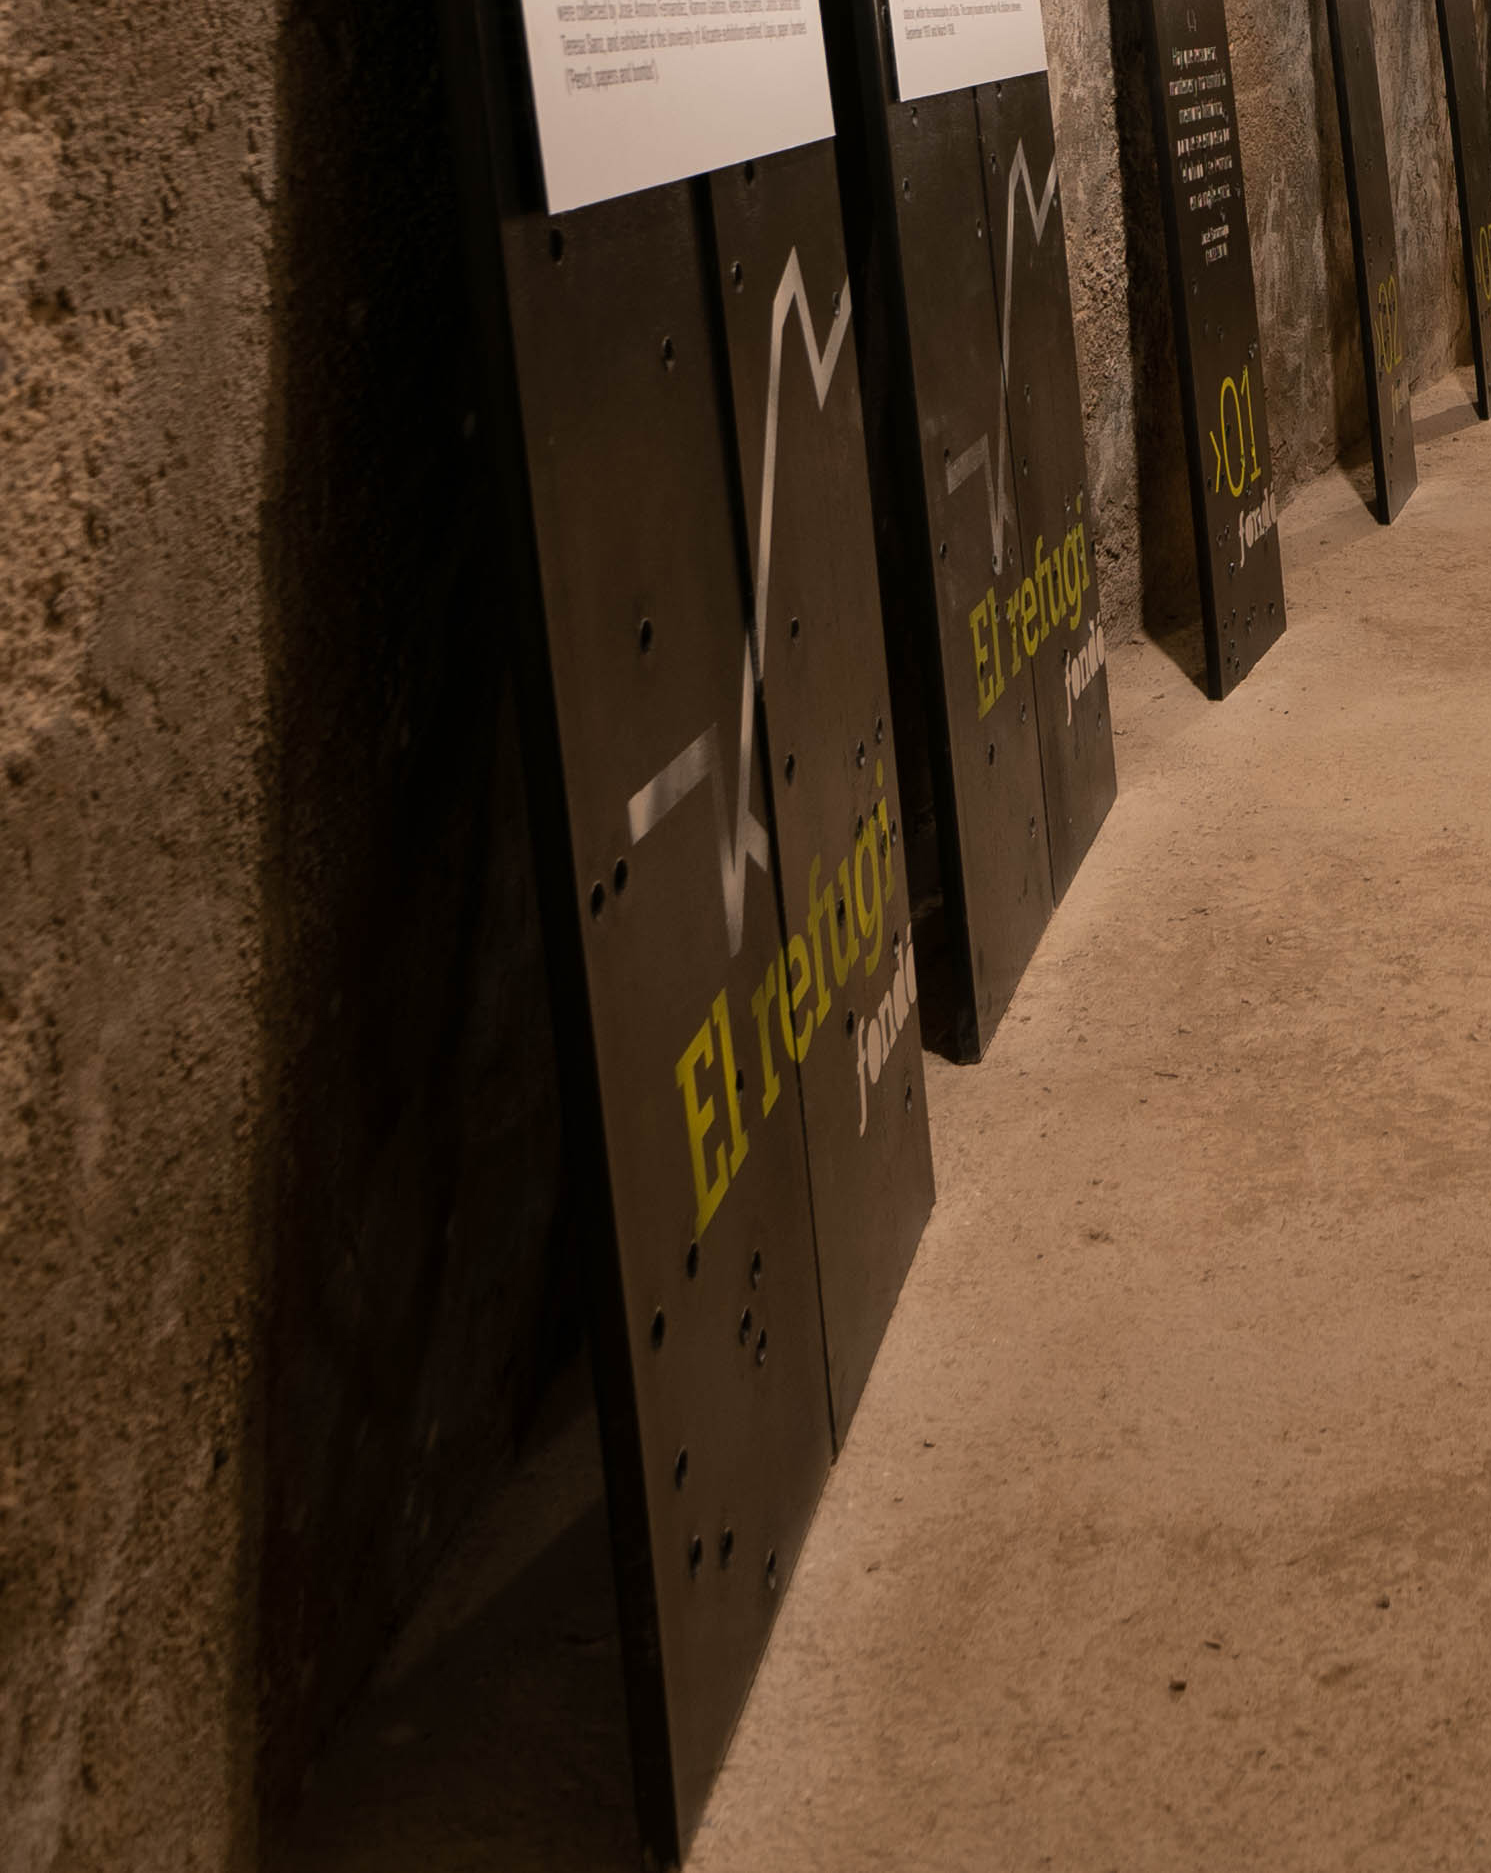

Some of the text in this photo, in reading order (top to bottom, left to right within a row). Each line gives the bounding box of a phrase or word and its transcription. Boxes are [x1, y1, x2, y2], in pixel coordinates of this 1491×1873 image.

[969, 496, 1089, 721] El refugi
[1064, 613, 1105, 727] fondó
[675, 758, 896, 1241] El refugi
[856, 923, 919, 1139] fondó
